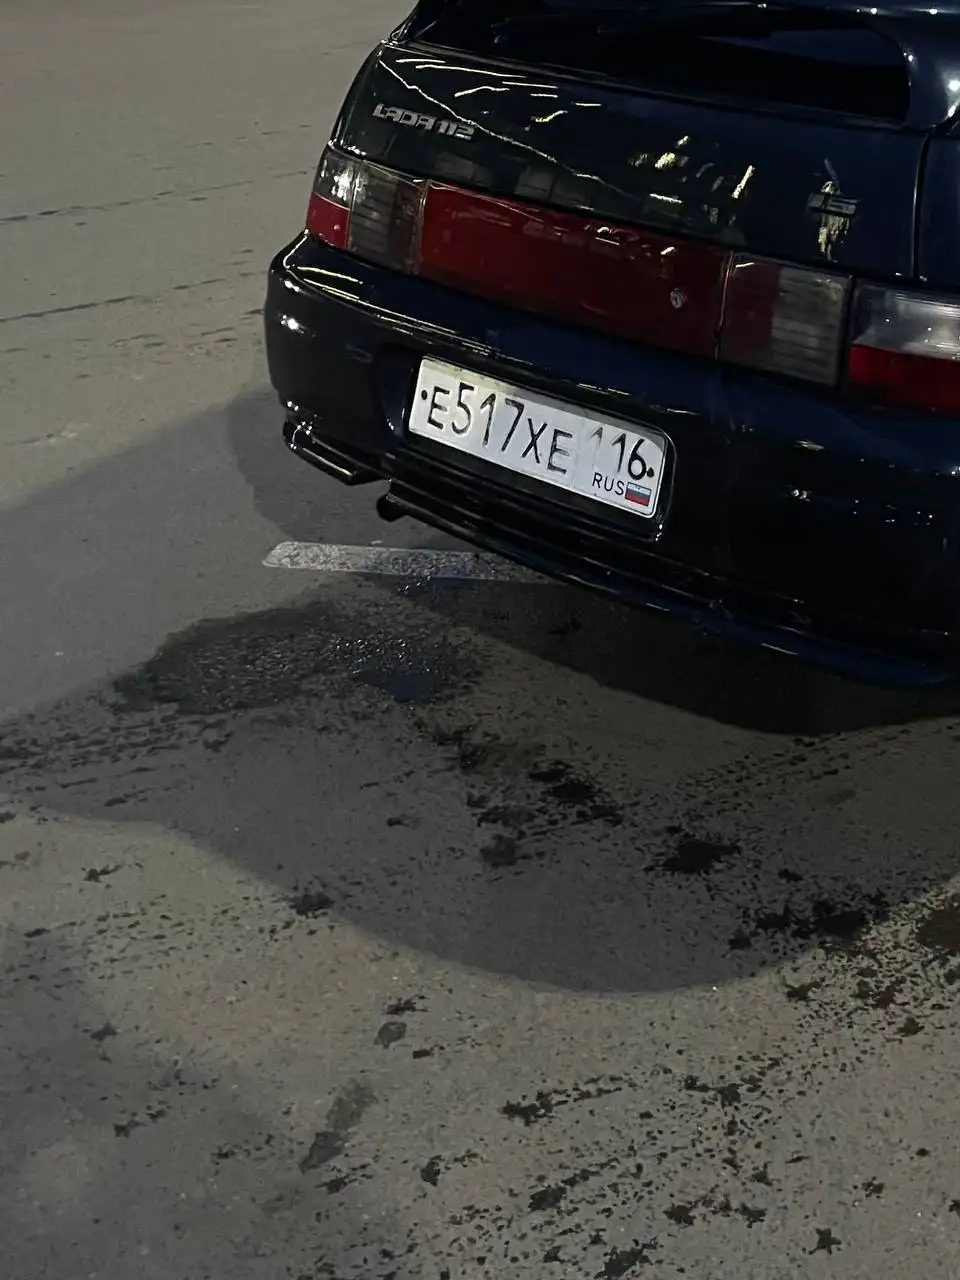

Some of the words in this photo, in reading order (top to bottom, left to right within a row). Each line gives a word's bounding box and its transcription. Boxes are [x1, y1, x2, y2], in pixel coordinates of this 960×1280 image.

[372, 103, 437, 131] LADA
[437, 120, 476, 141] 112
[592, 472, 625, 497] RUS
